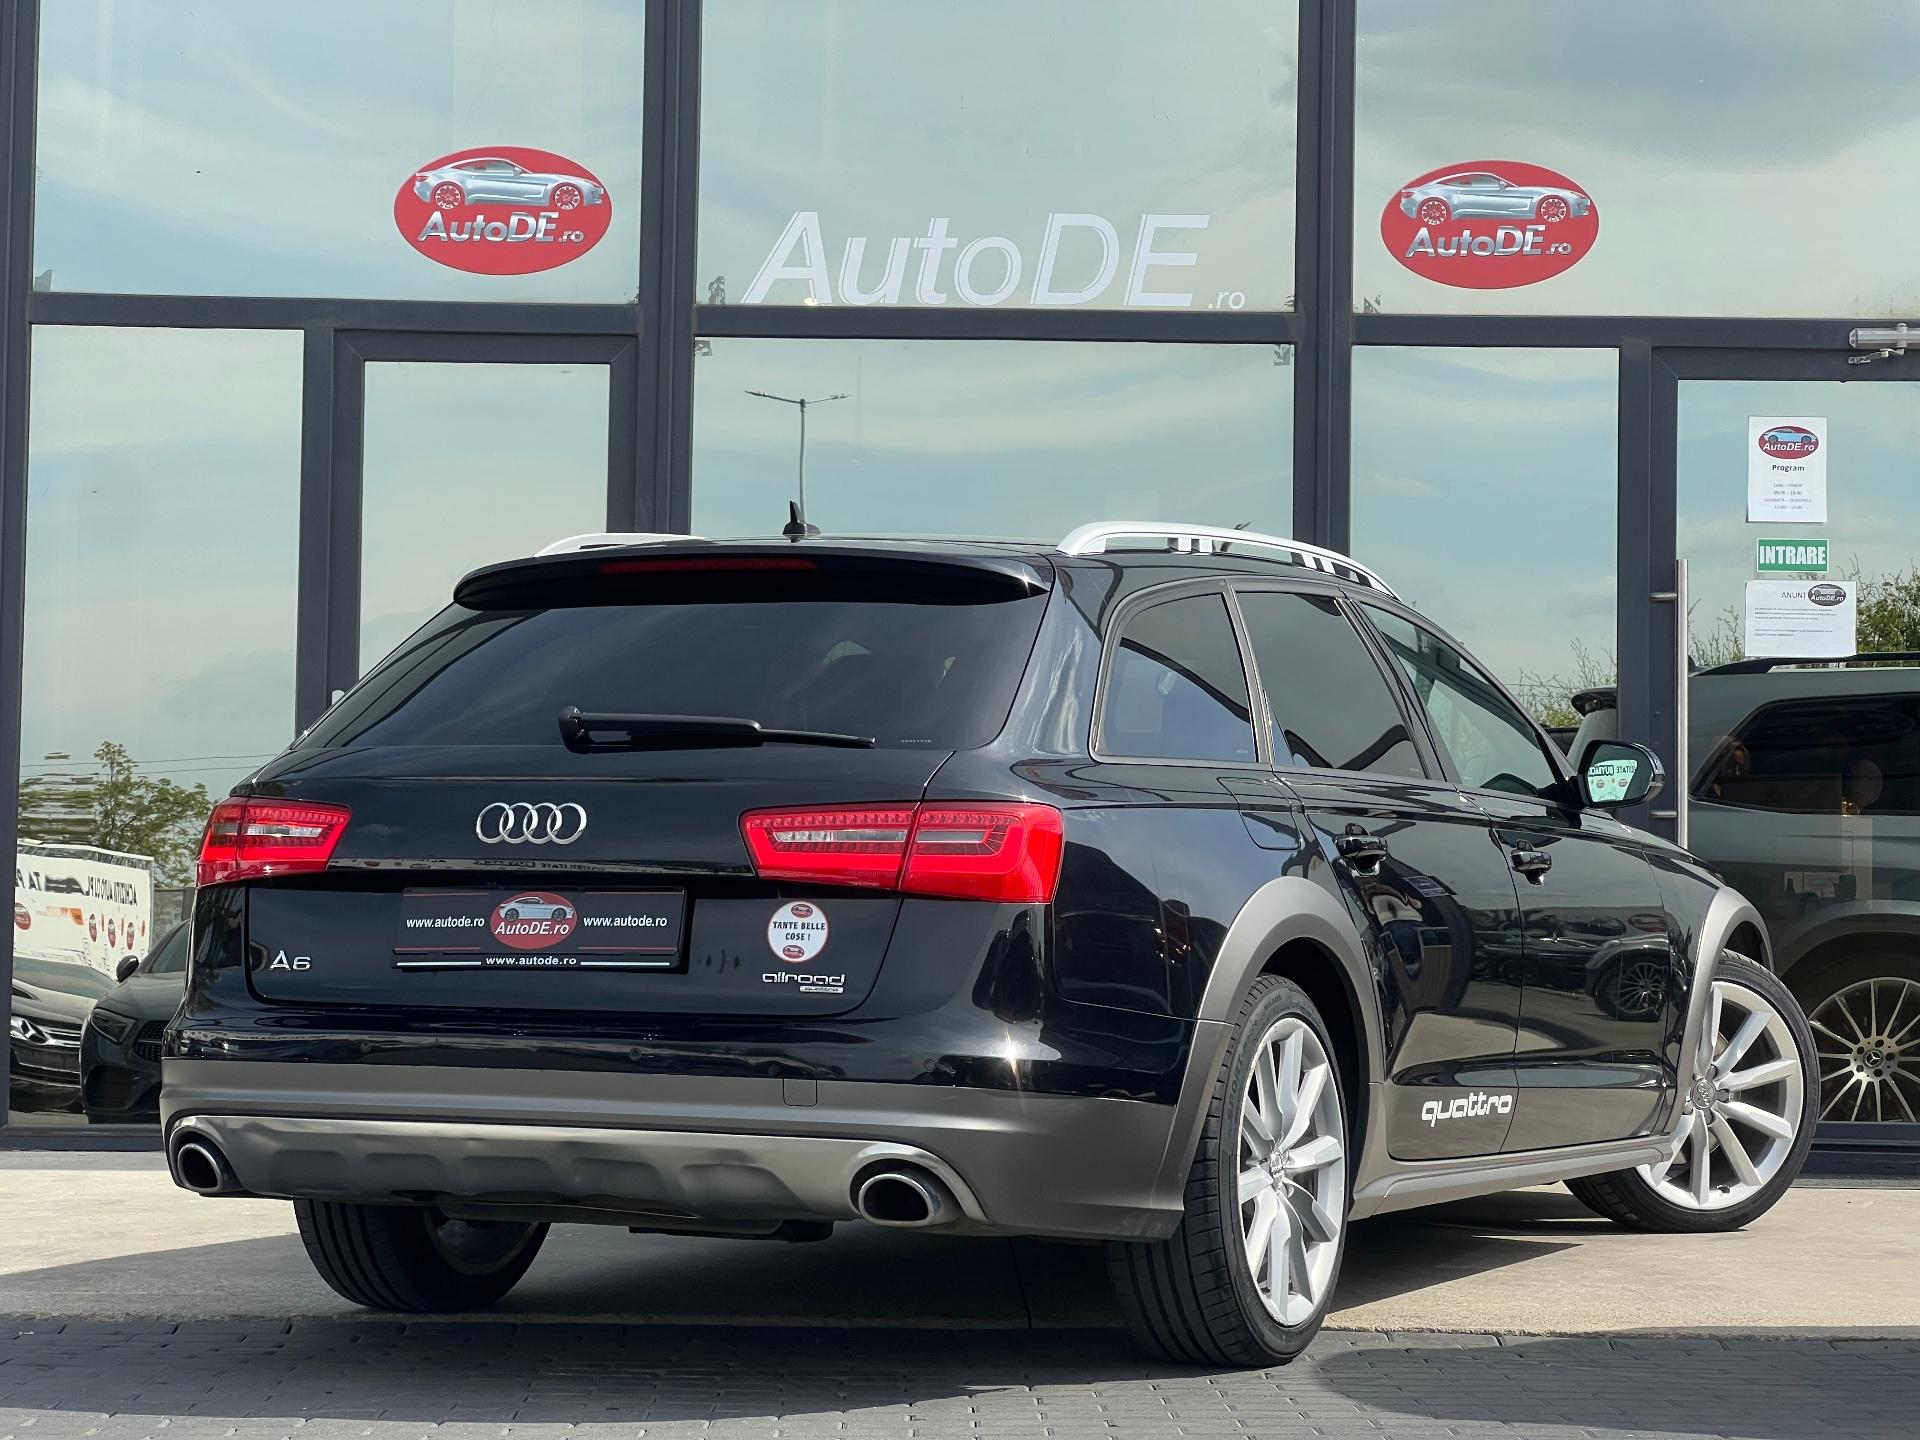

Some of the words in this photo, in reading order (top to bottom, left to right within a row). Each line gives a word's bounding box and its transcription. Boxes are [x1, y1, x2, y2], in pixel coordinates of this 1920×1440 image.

[1762, 442, 1815, 452] AutoDE.ro
[1772, 464, 1805, 472] Program
[1760, 546, 1826, 564] INTRARE
[406, 916, 485, 928] www.autode.ro
[583, 915, 668, 927] www.autode.ro
[773, 921, 799, 930] TANTE
[801, 922, 826, 931] BELLE
[495, 921, 570, 935] AutoDE.ro
[785, 933, 806, 941] COSE
[268, 950, 311, 971] A6
[486, 956, 577, 966] www.autode.ro
[762, 971, 845, 986] allroad
[1421, 1091, 1513, 1128] quattro
